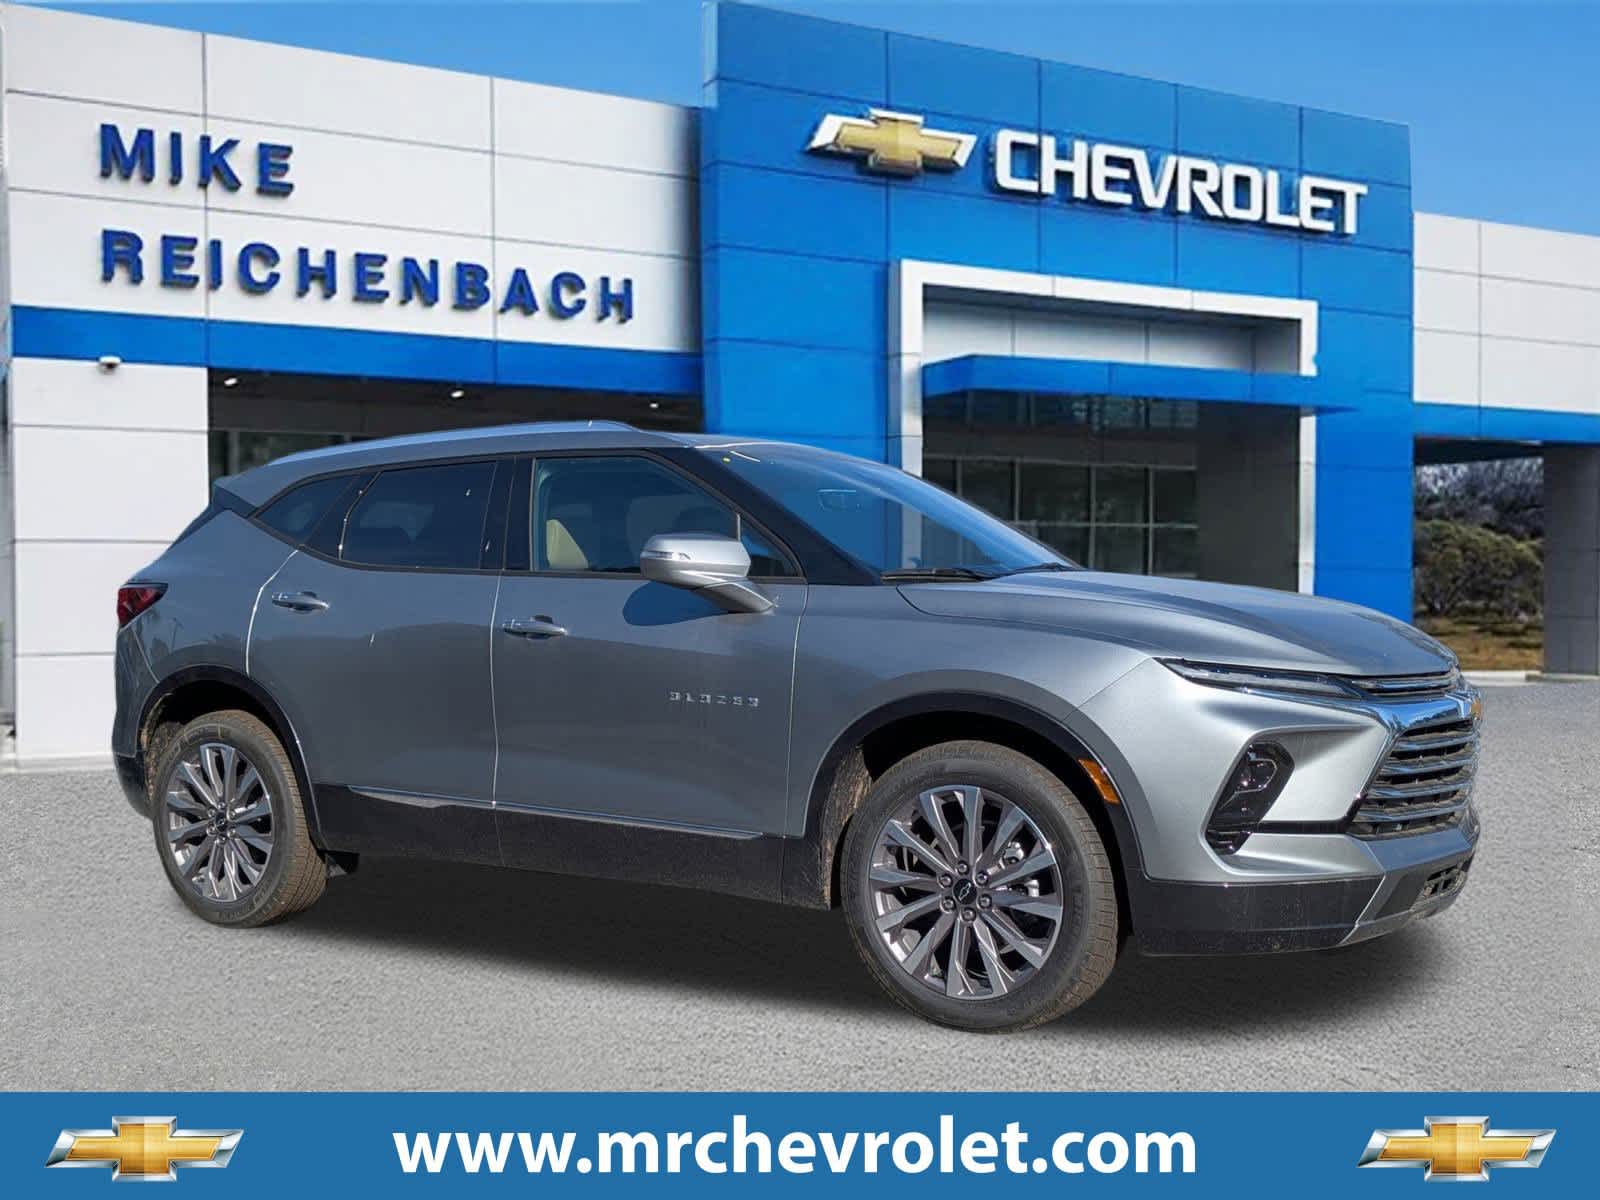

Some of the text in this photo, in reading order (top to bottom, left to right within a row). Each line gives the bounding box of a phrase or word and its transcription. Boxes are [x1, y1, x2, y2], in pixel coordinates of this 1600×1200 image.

[99, 123, 295, 196] MIKE
[995, 129, 1368, 234] CHEVROLET
[101, 229, 635, 323] REICHENBACH
